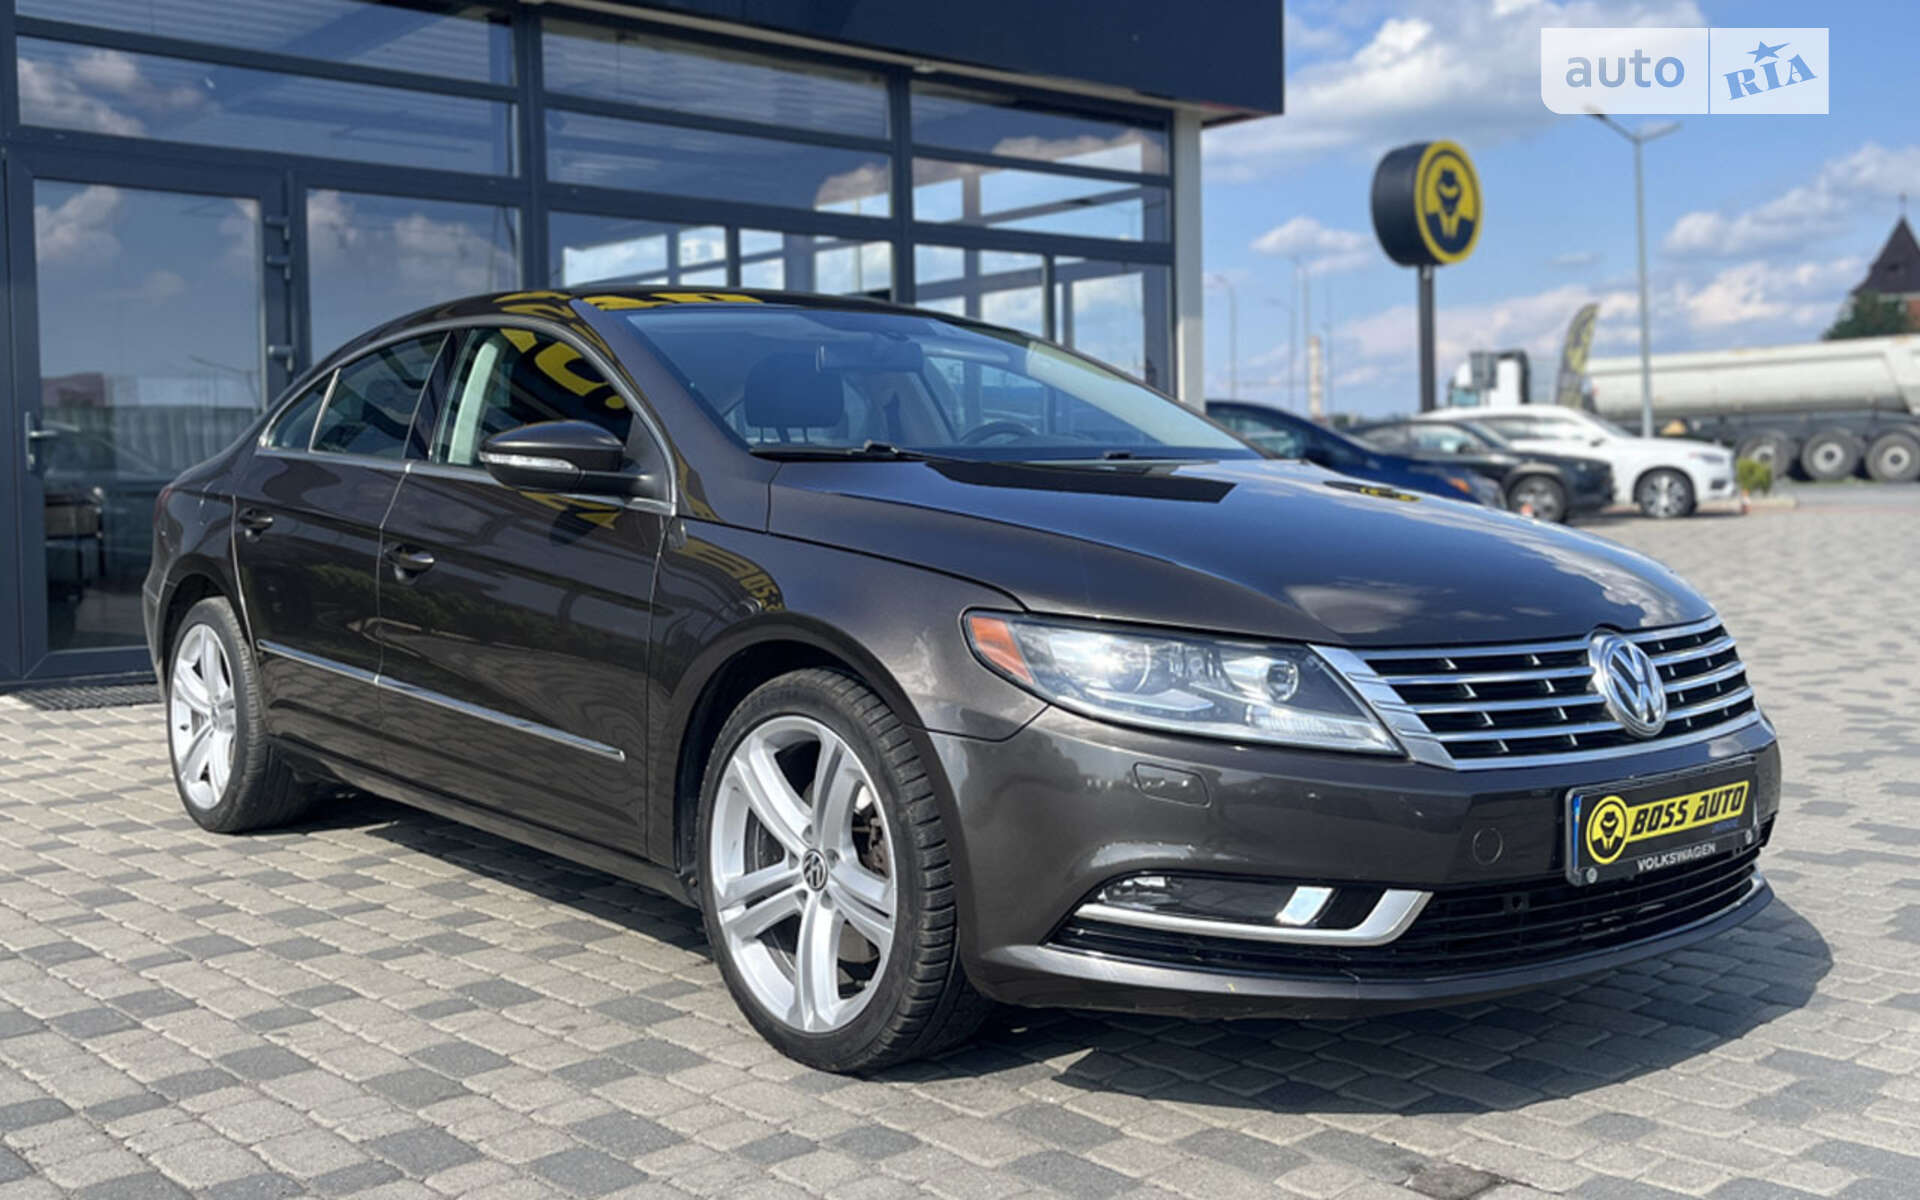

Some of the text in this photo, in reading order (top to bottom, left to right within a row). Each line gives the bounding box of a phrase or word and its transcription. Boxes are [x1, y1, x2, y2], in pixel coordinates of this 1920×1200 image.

[1630, 799, 1689, 836] BOSS
[1693, 785, 1745, 823] AUTO
[1636, 842, 1716, 872] VOLKSWAGEN
